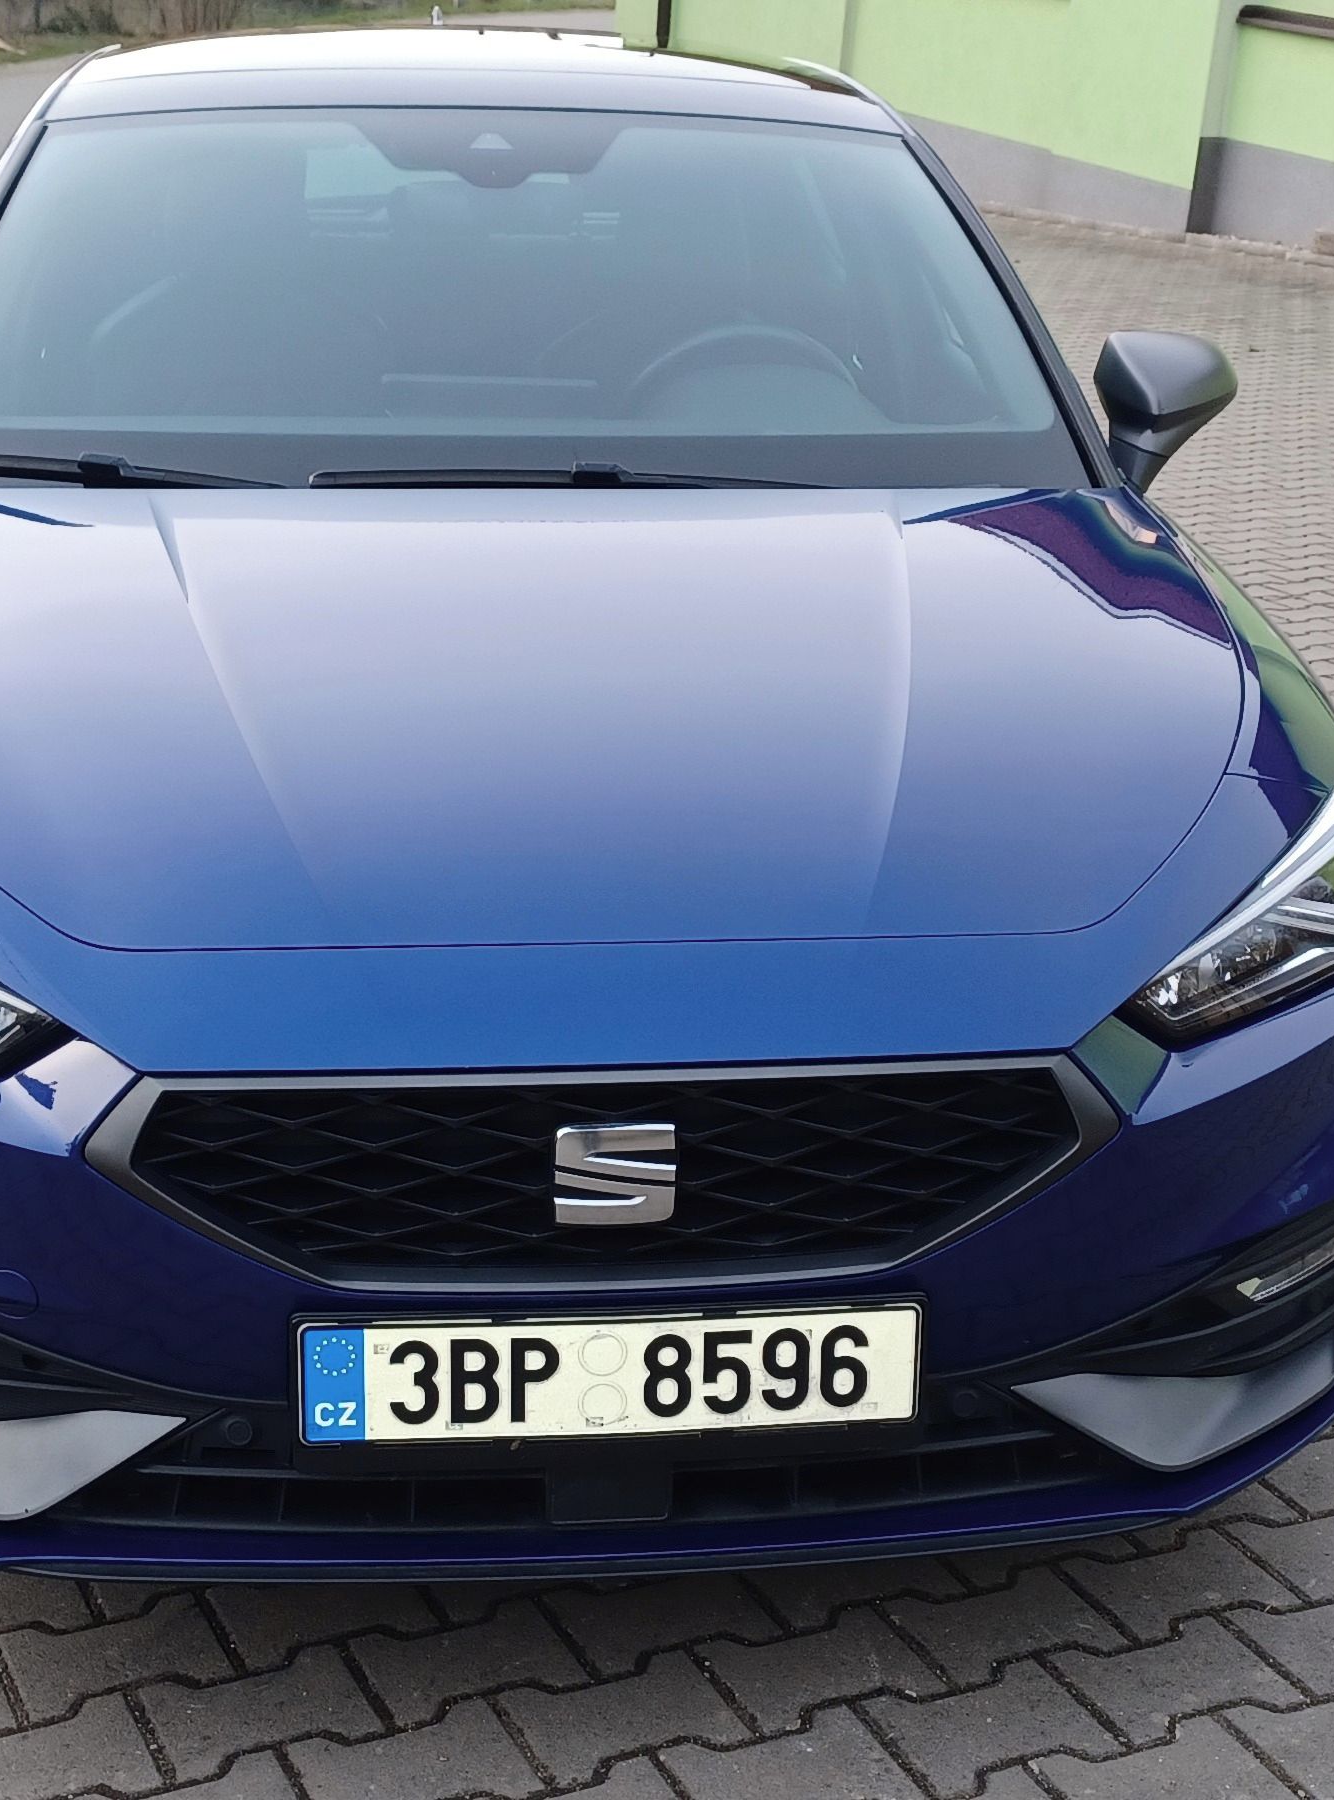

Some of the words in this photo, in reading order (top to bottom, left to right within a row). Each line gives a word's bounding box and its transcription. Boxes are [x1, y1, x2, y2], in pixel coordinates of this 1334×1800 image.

[389, 1338, 560, 1425] 3BP
[643, 1324, 869, 1418] 8596
[314, 1401, 357, 1427] CZ
